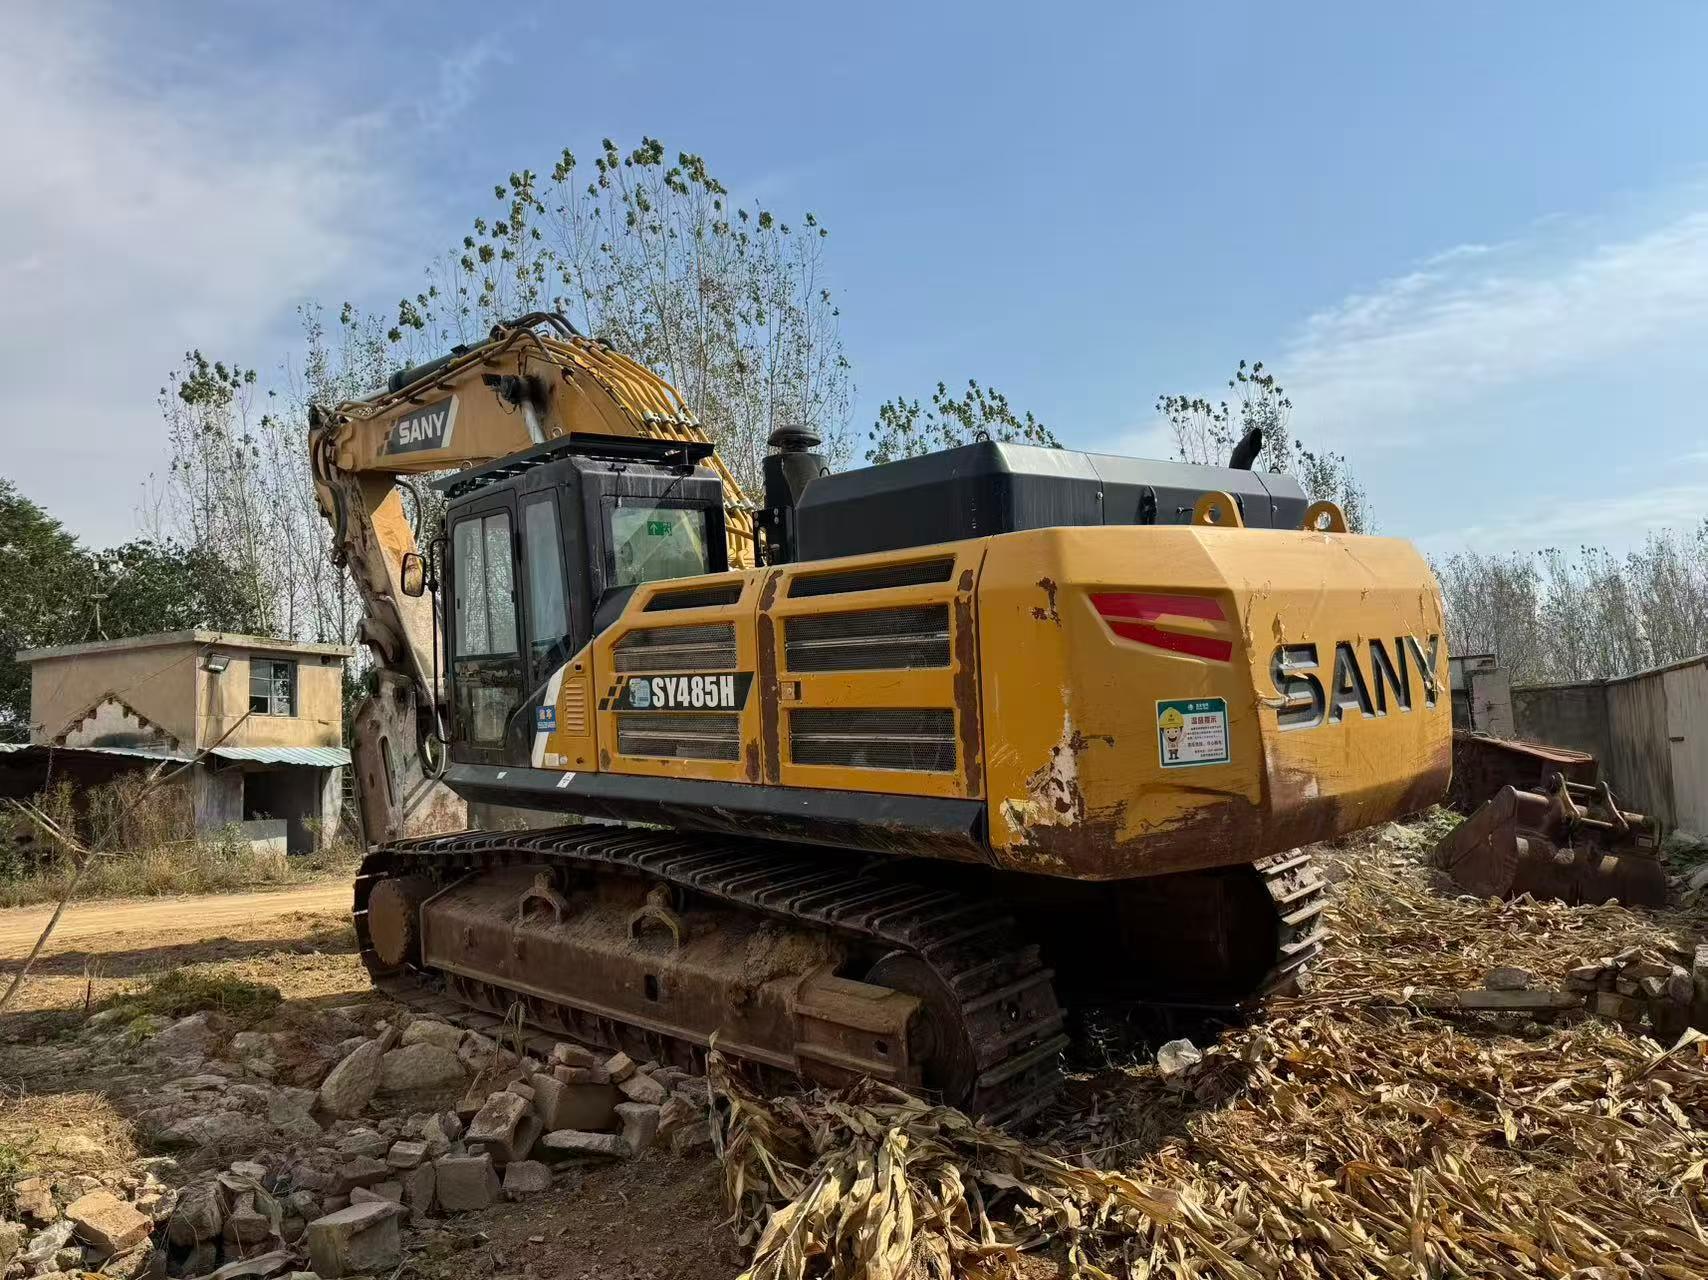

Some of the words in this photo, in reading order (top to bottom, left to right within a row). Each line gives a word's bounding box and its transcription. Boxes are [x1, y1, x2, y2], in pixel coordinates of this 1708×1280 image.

[399, 411, 445, 445] SANY
[651, 675, 735, 707] SY485H
[1270, 634, 1439, 732] SANY
